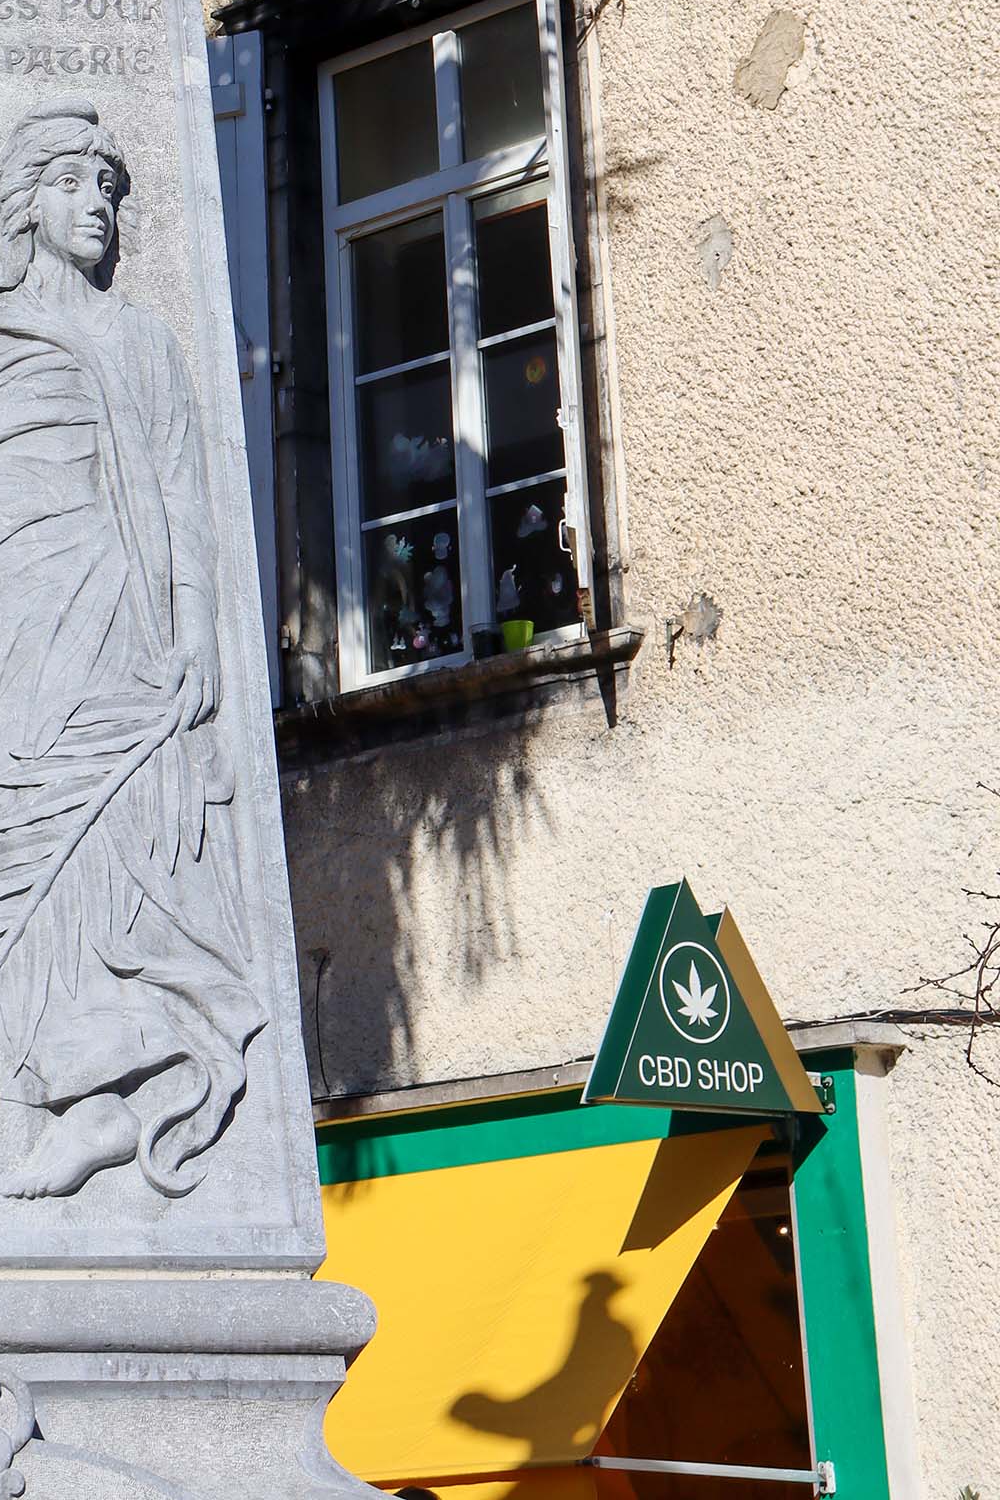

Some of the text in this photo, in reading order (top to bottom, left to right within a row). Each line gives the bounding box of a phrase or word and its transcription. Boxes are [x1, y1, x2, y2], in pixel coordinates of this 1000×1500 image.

[3, 45, 155, 76] PATRIE
[638, 1054, 764, 1093] CBD SHOP
